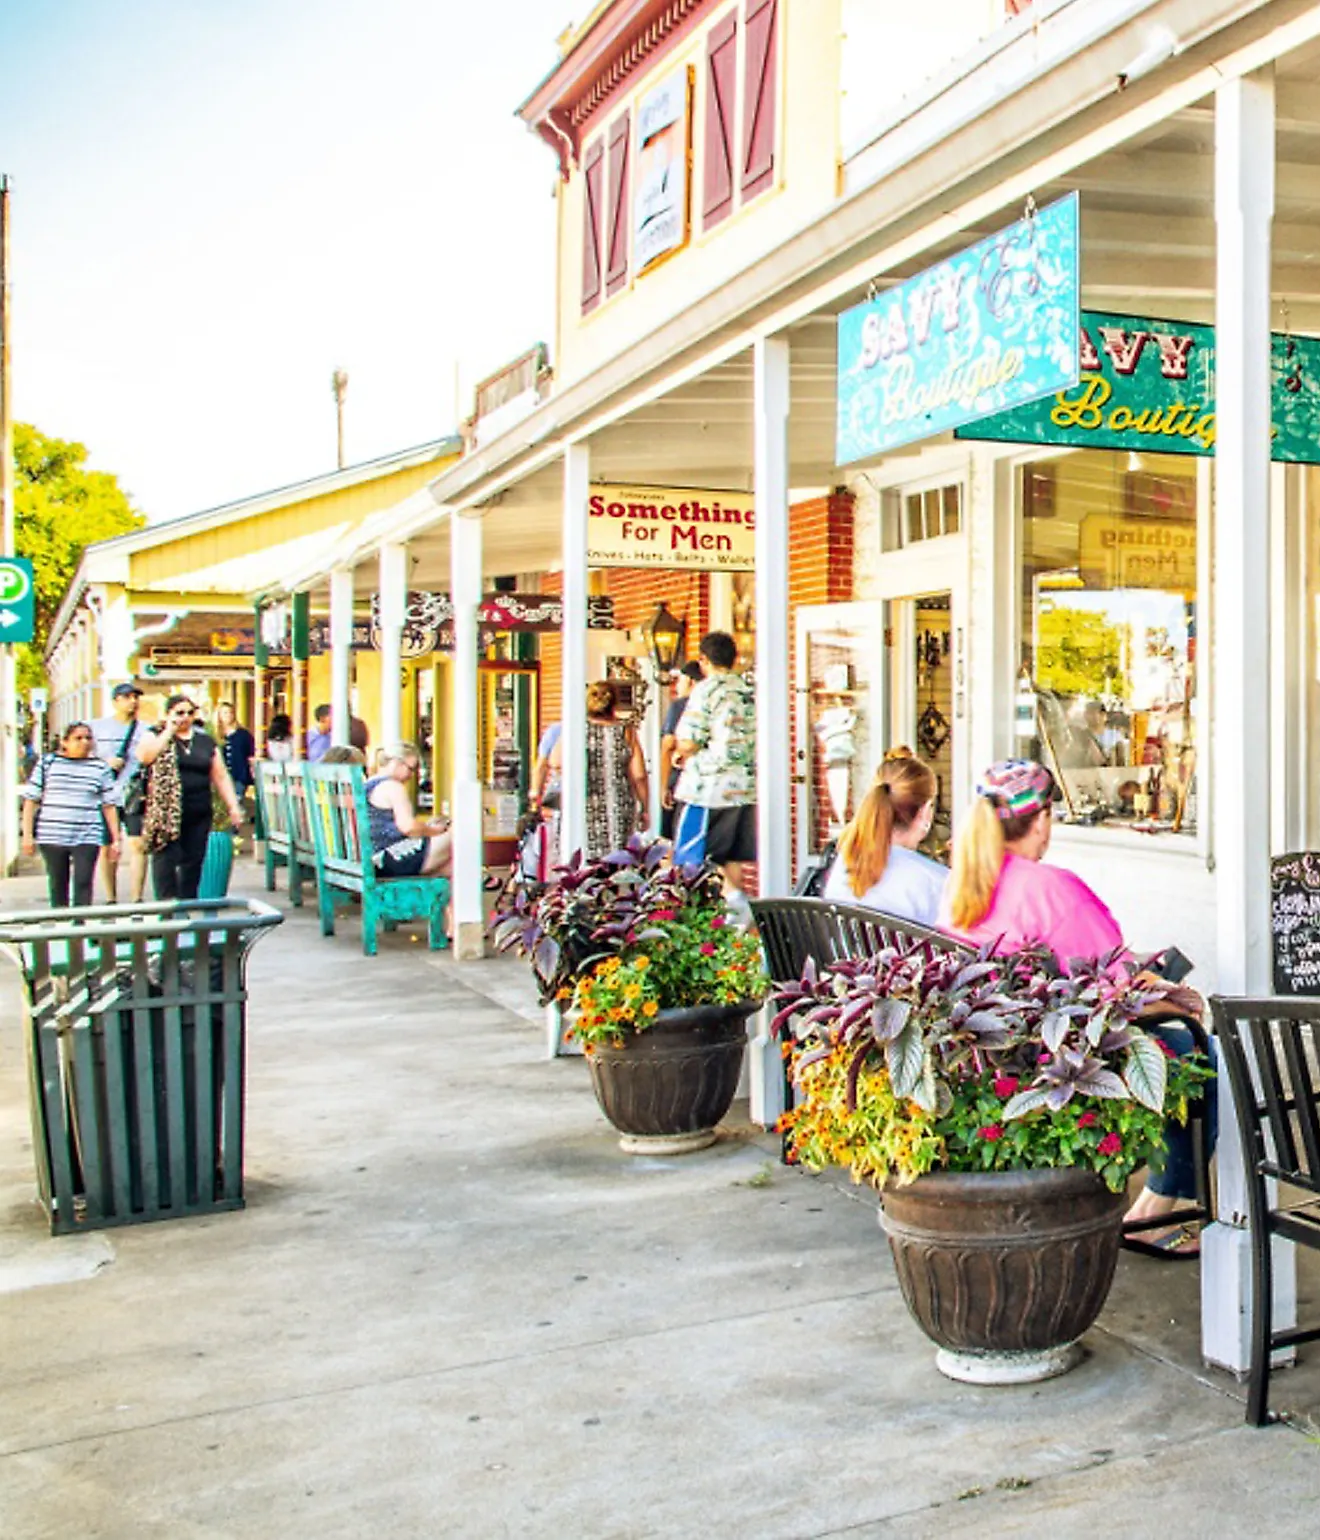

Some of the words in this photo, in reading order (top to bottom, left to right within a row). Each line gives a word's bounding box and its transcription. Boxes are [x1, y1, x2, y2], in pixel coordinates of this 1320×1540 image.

[862, 266, 966, 369] SAVY
[880, 340, 1025, 426] Boutique
[1080, 326, 1195, 379] AVY
[621, 521, 660, 541] For
[670, 524, 732, 551] Men
